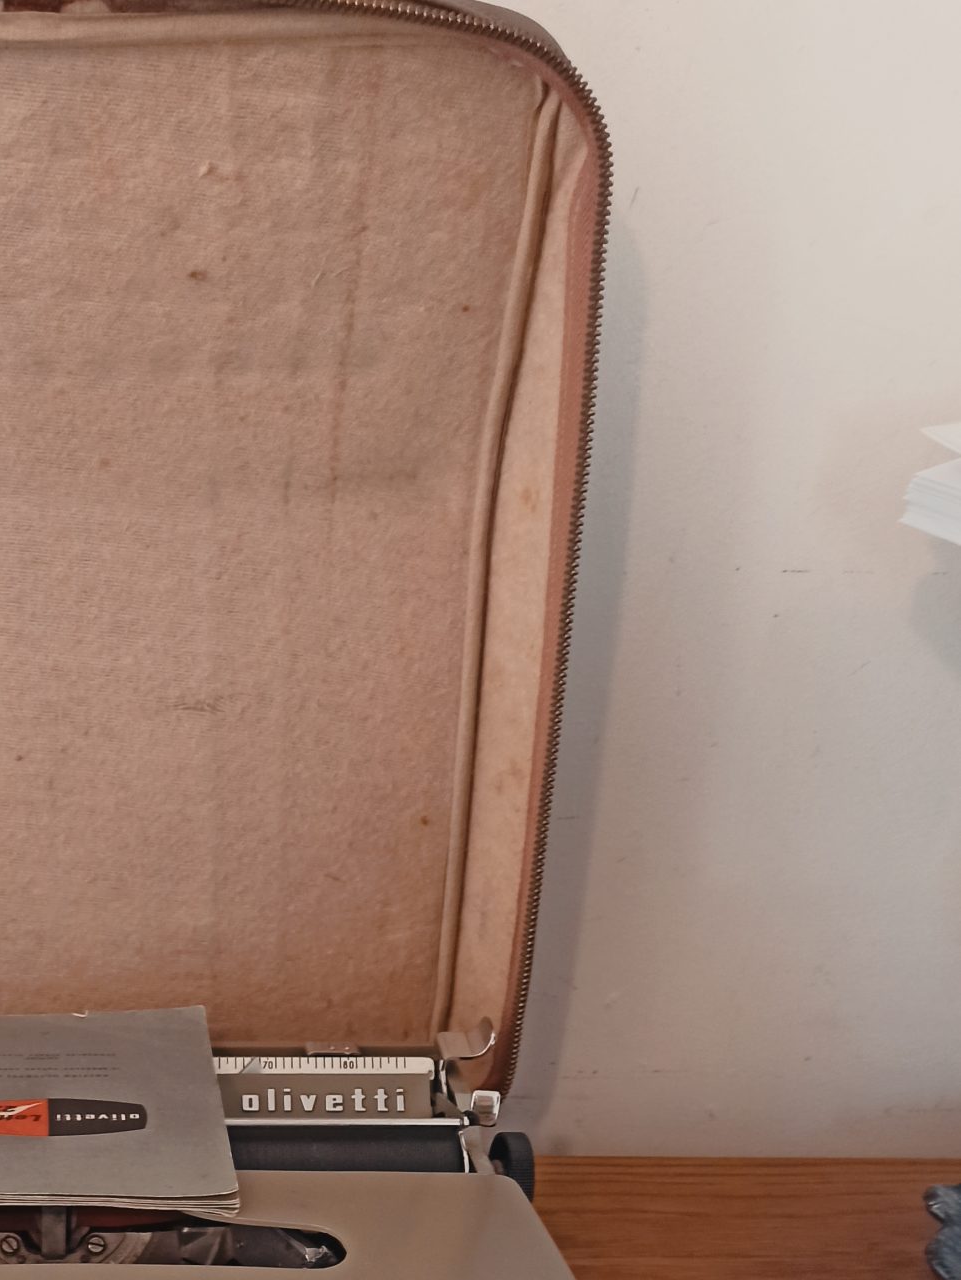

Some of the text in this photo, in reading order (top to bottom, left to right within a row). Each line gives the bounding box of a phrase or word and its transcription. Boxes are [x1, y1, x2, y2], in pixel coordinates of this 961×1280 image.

[261, 1060, 274, 1070] 70
[343, 1060, 355, 1070] 80
[241, 1088, 406, 1112] olivetti
[55, 1113, 140, 1122] olivetti
